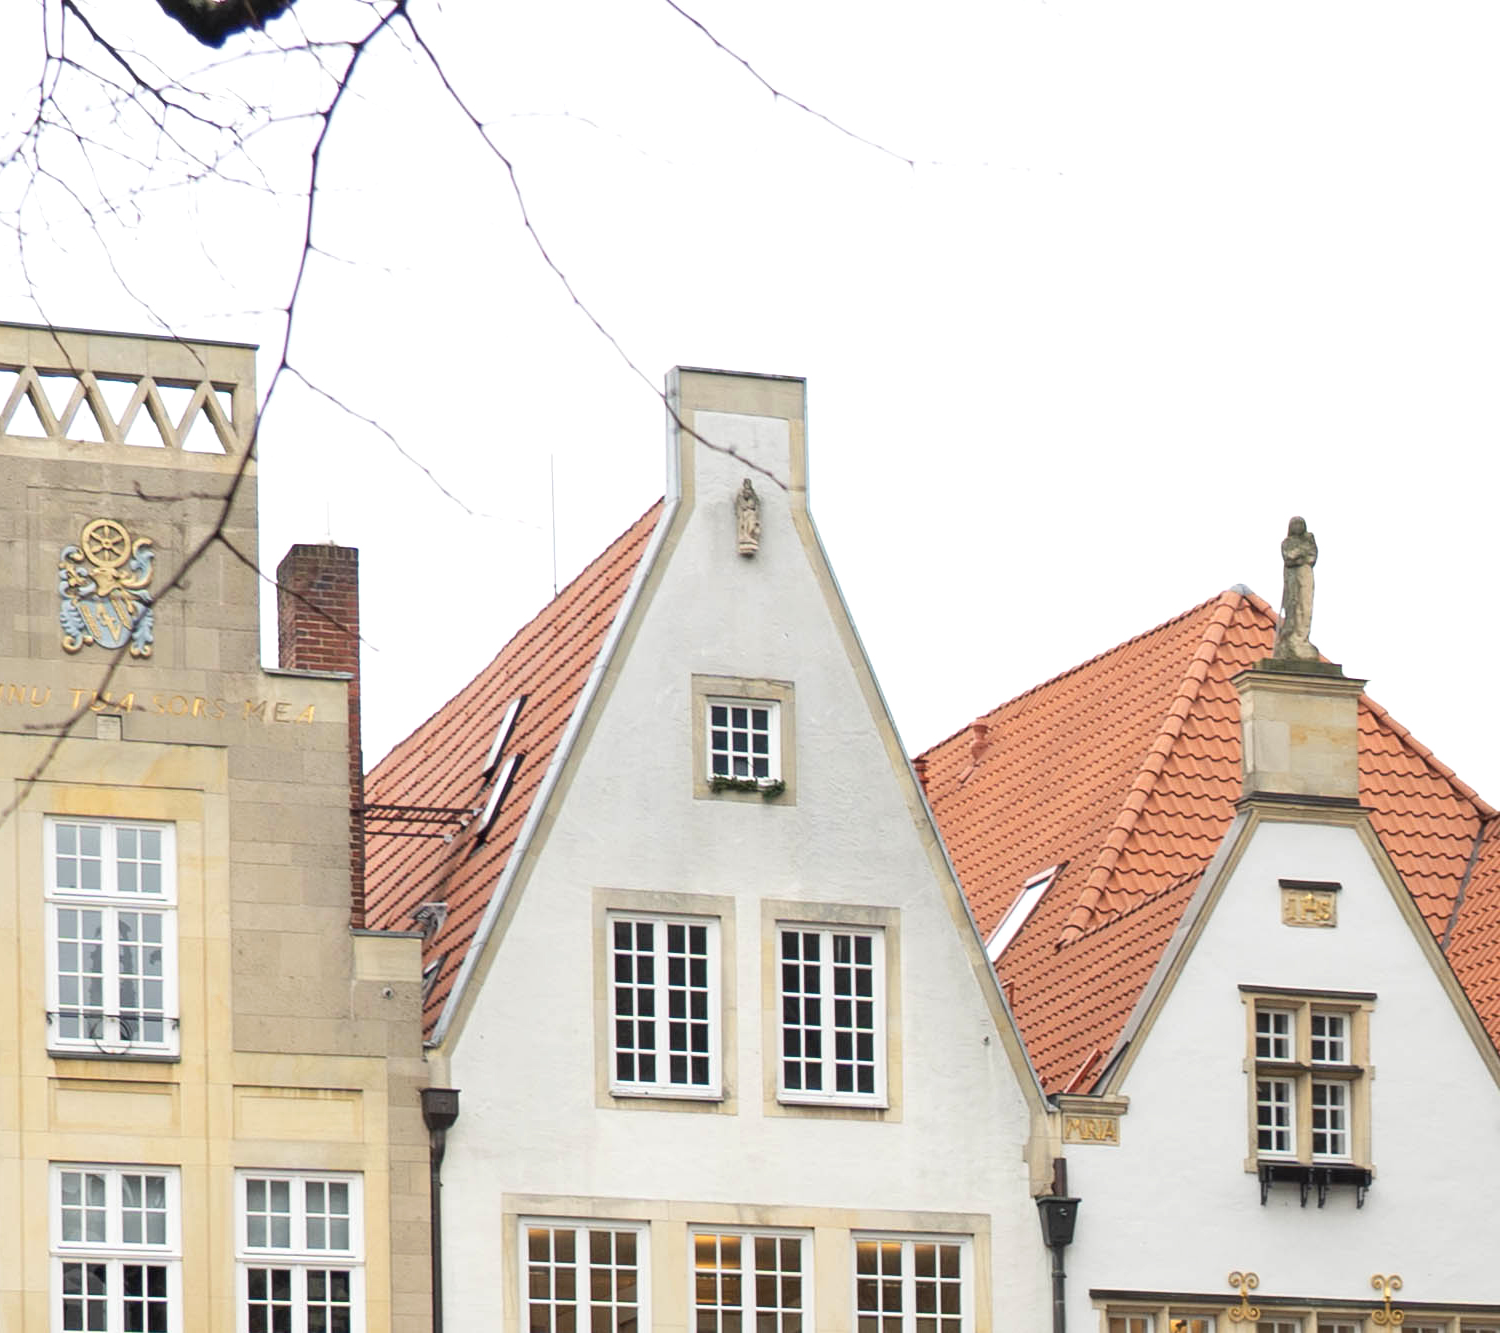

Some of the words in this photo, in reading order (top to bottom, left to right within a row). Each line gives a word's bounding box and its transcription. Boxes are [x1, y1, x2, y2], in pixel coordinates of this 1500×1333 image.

[67, 686, 136, 714] TUA
[152, 693, 227, 721] SORS
[241, 698, 316, 725] MEA
